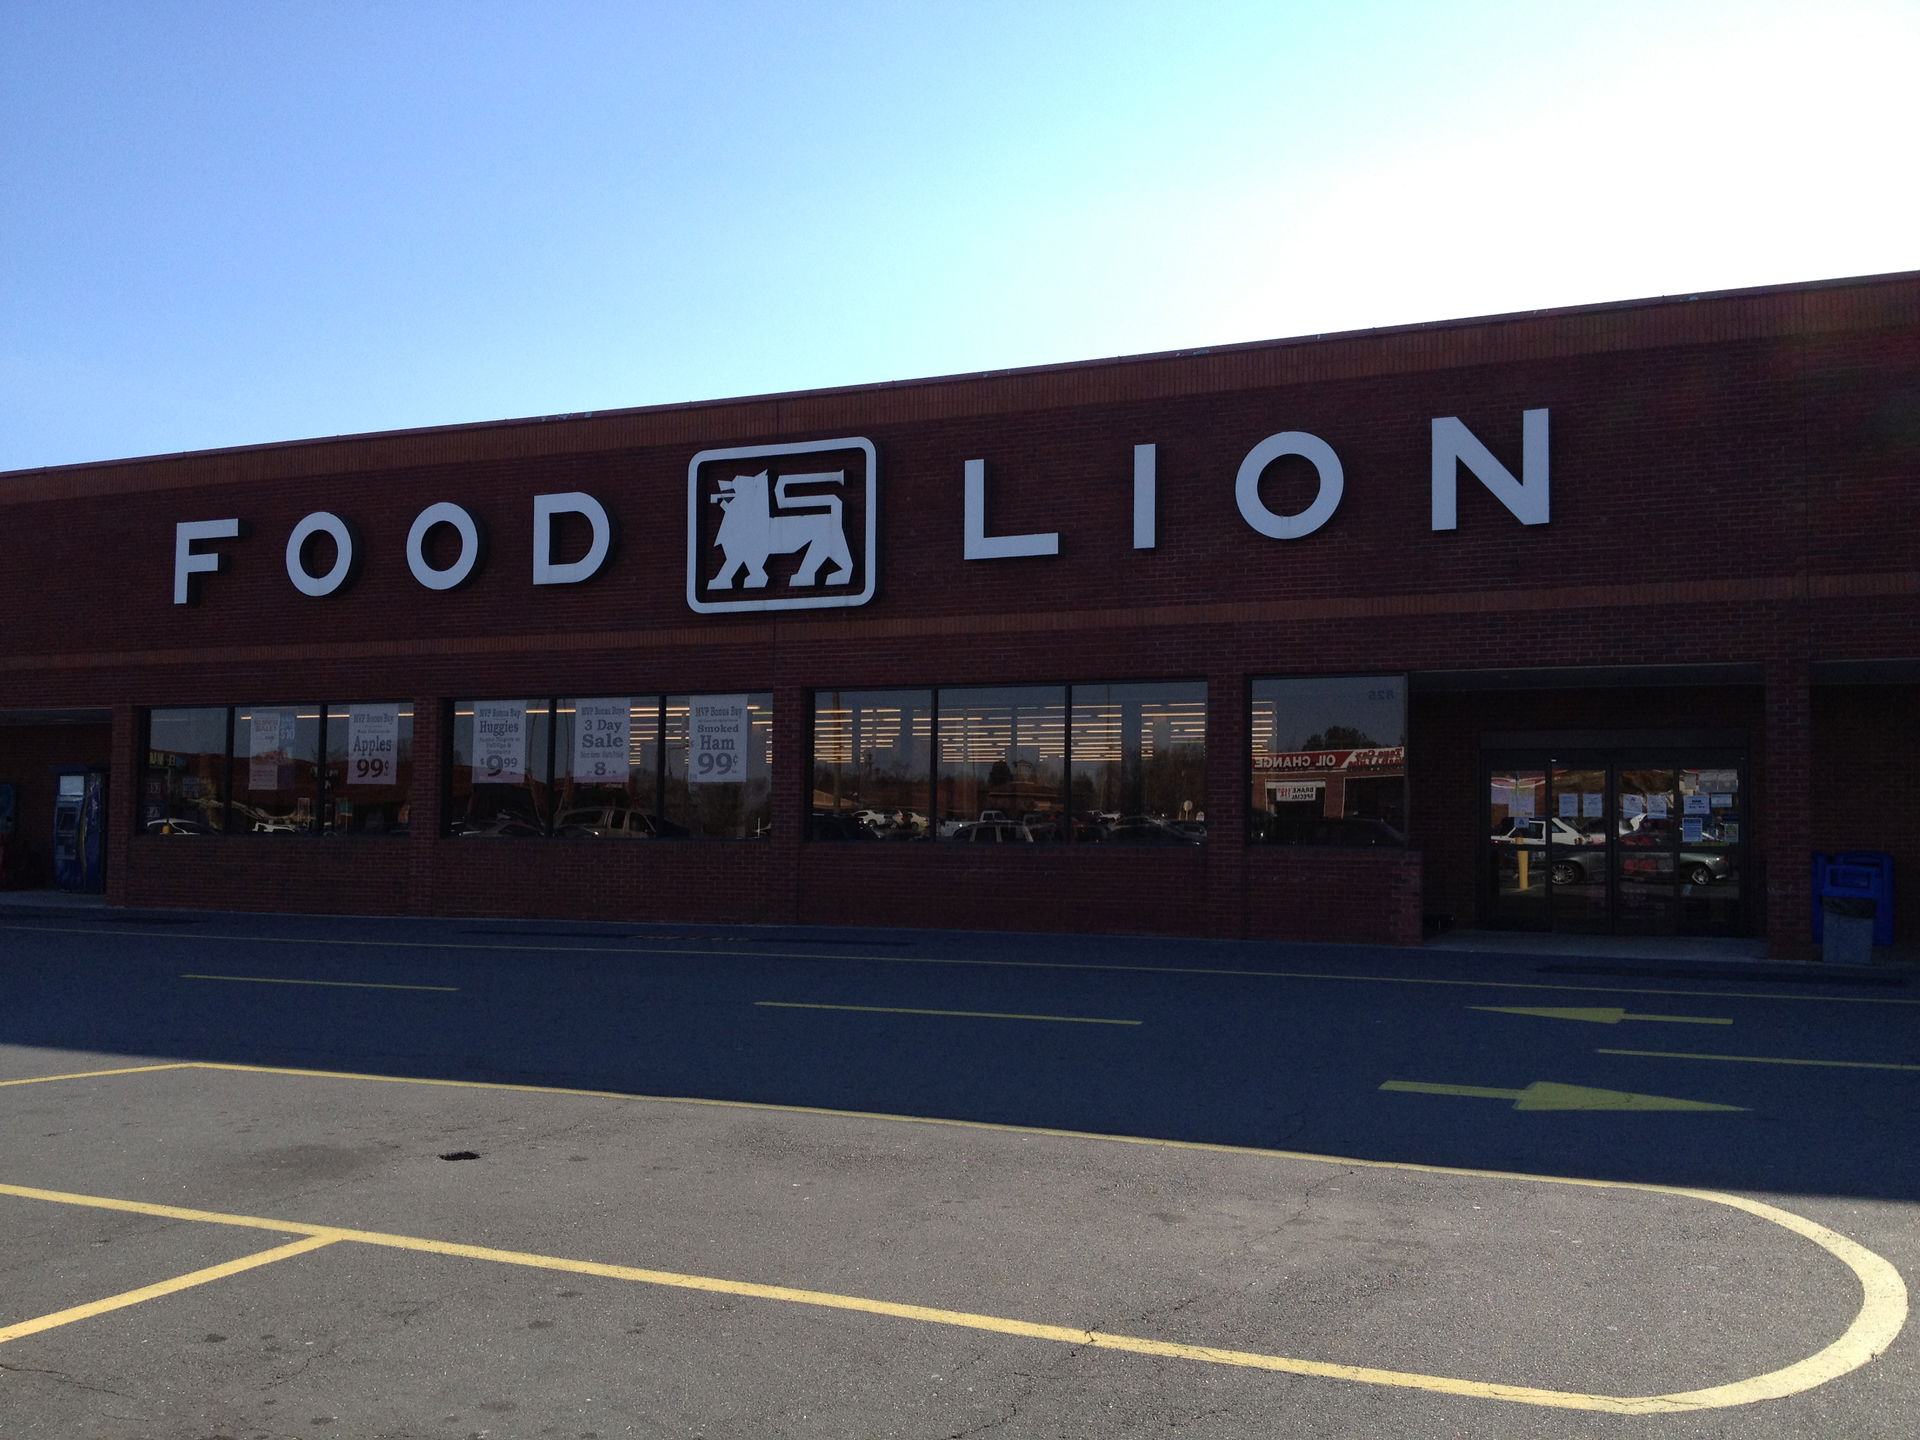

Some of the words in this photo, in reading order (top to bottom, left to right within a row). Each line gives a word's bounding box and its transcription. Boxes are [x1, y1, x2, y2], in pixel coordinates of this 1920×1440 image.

[173, 491, 611, 605] FOOD
[963, 407, 1550, 560] LION
[479, 720, 519, 737] Huggies
[584, 719, 593, 731] 3
[597, 719, 623, 733] Day
[697, 724, 739, 733] Smoked
[353, 735, 392, 756] Apples
[582, 733, 624, 749] Sale
[700, 734, 736, 751] Ham
